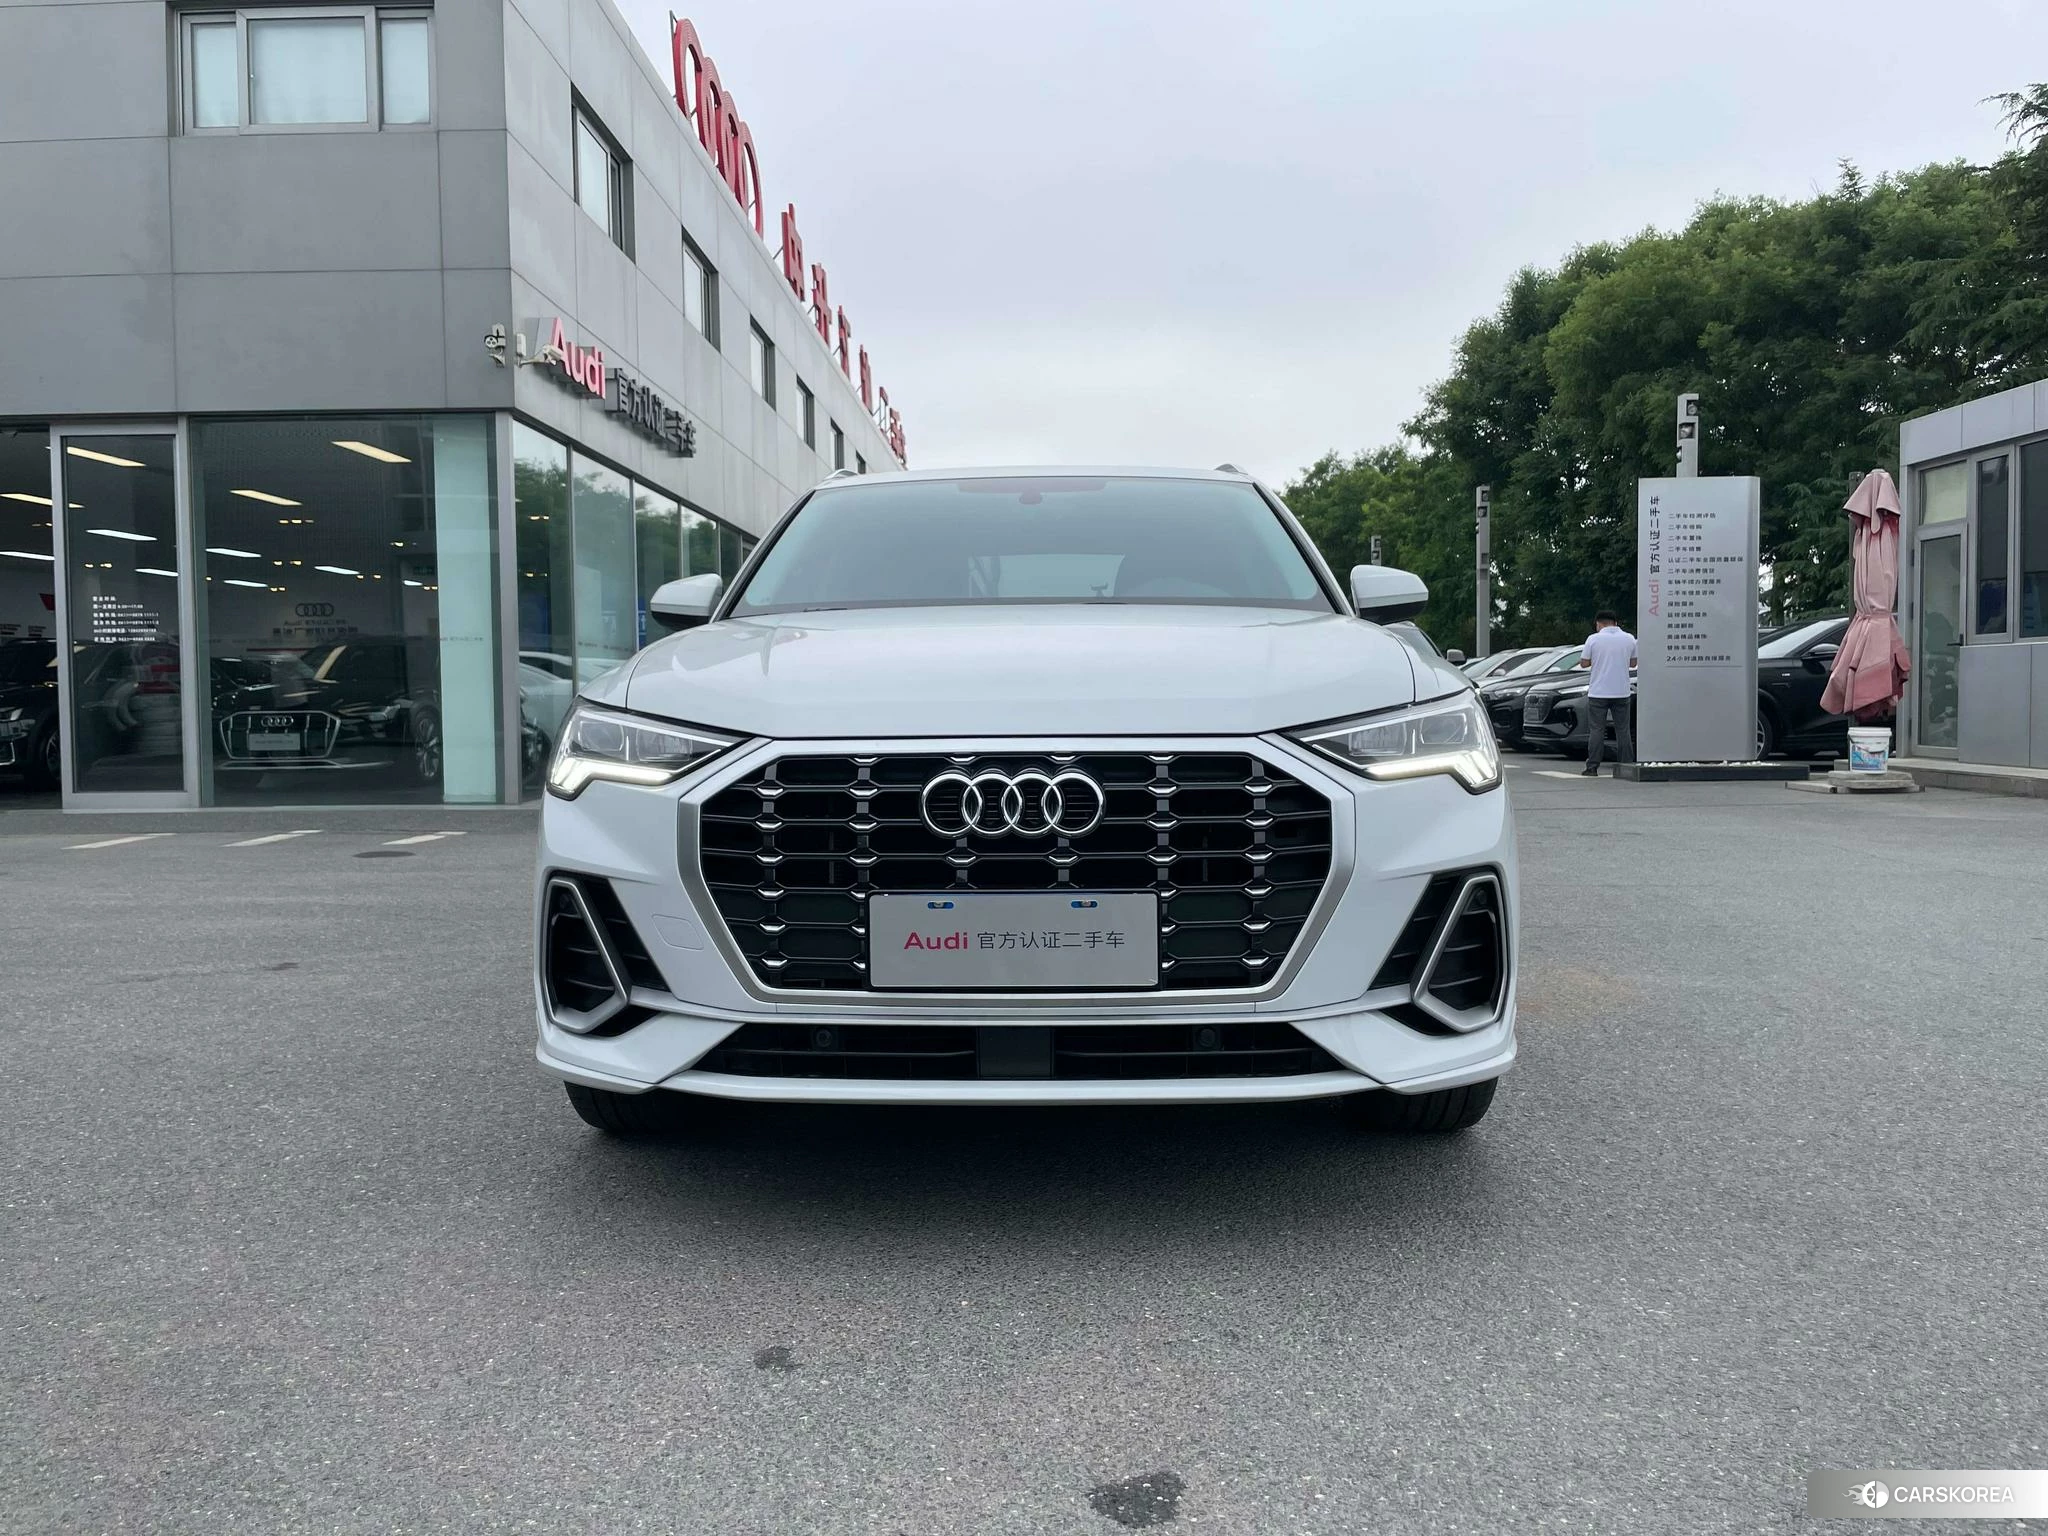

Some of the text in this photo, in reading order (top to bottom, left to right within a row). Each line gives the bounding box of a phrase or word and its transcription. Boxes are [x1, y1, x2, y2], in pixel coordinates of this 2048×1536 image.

[550, 316, 605, 399] Audi
[1648, 495, 1660, 617] Audi 官方认证二手车
[903, 930, 1126, 950] Audi 官方认证二手车
